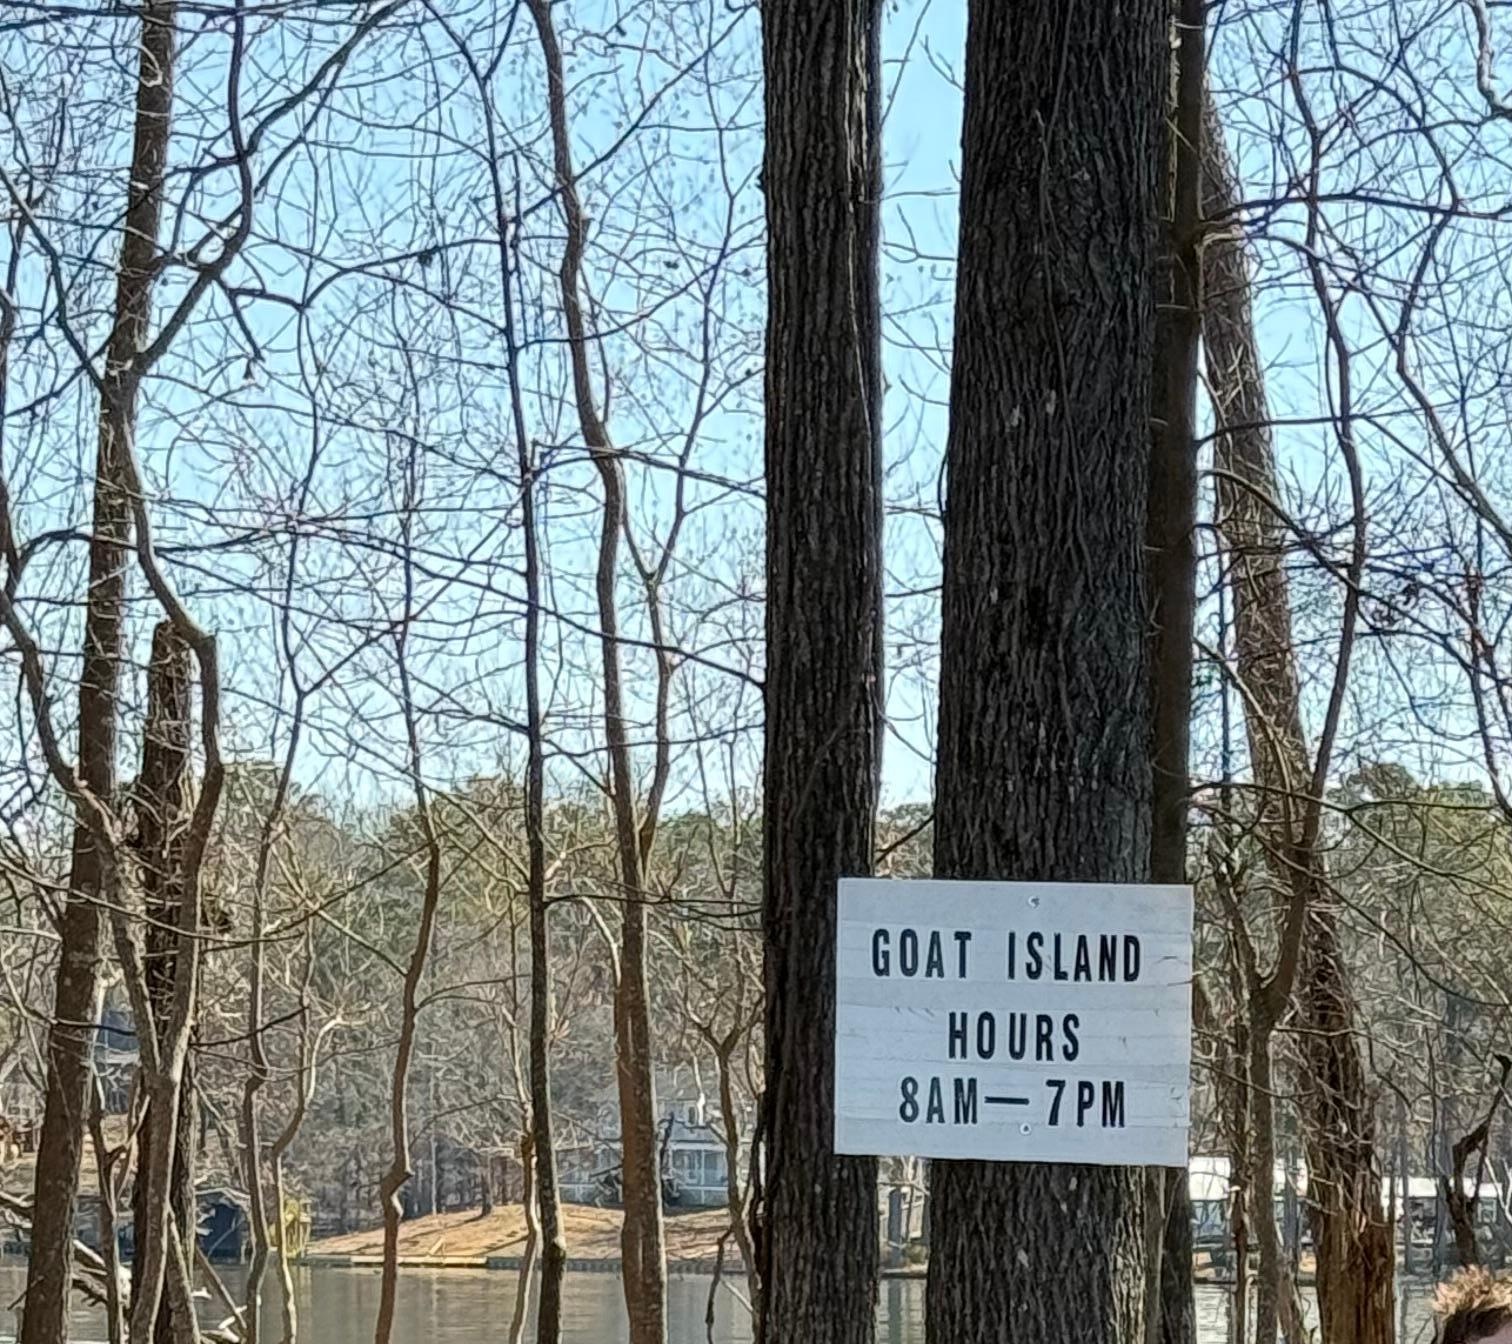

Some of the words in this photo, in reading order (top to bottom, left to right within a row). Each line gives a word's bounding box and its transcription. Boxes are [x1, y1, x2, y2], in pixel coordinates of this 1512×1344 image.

[871, 927, 973, 980] GOAT
[1006, 930, 1142, 984] ISLAND
[947, 1010, 1081, 1063] HOURS
